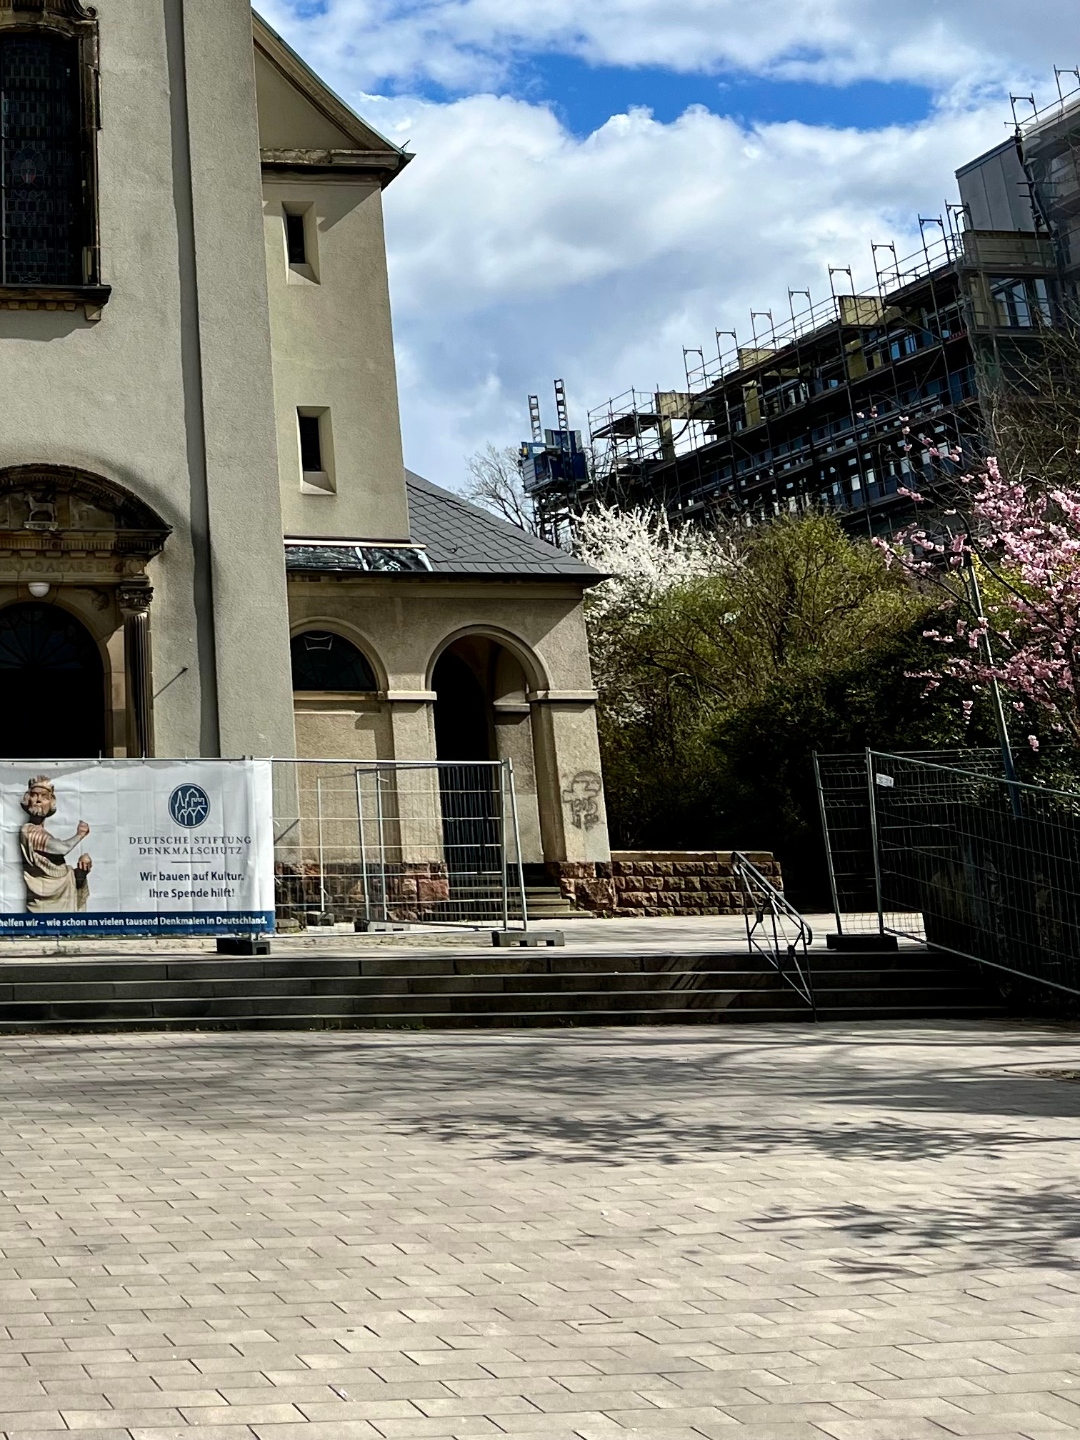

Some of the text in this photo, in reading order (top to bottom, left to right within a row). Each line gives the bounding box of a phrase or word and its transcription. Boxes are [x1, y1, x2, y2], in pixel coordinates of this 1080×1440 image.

[25, 560, 44, 572] AD
[128, 836, 252, 845] DEUTSCHE STIFTUNG
[139, 846, 243, 855] DENKMALSCHUTZ
[139, 871, 245, 881] Wir bauen auf Kultur.
[148, 888, 235, 900] Ihre Spende hilft!
[25, 918, 39, 927] wir
[46, 918, 61, 927] wie
[62, 917, 87, 927] schon
[99, 917, 125, 926] vielen
[125, 916, 159, 926] tausend
[159, 916, 206, 925] Denkmalen
[207, 916, 215, 925] in
[216, 916, 268, 925] Deutschland.
